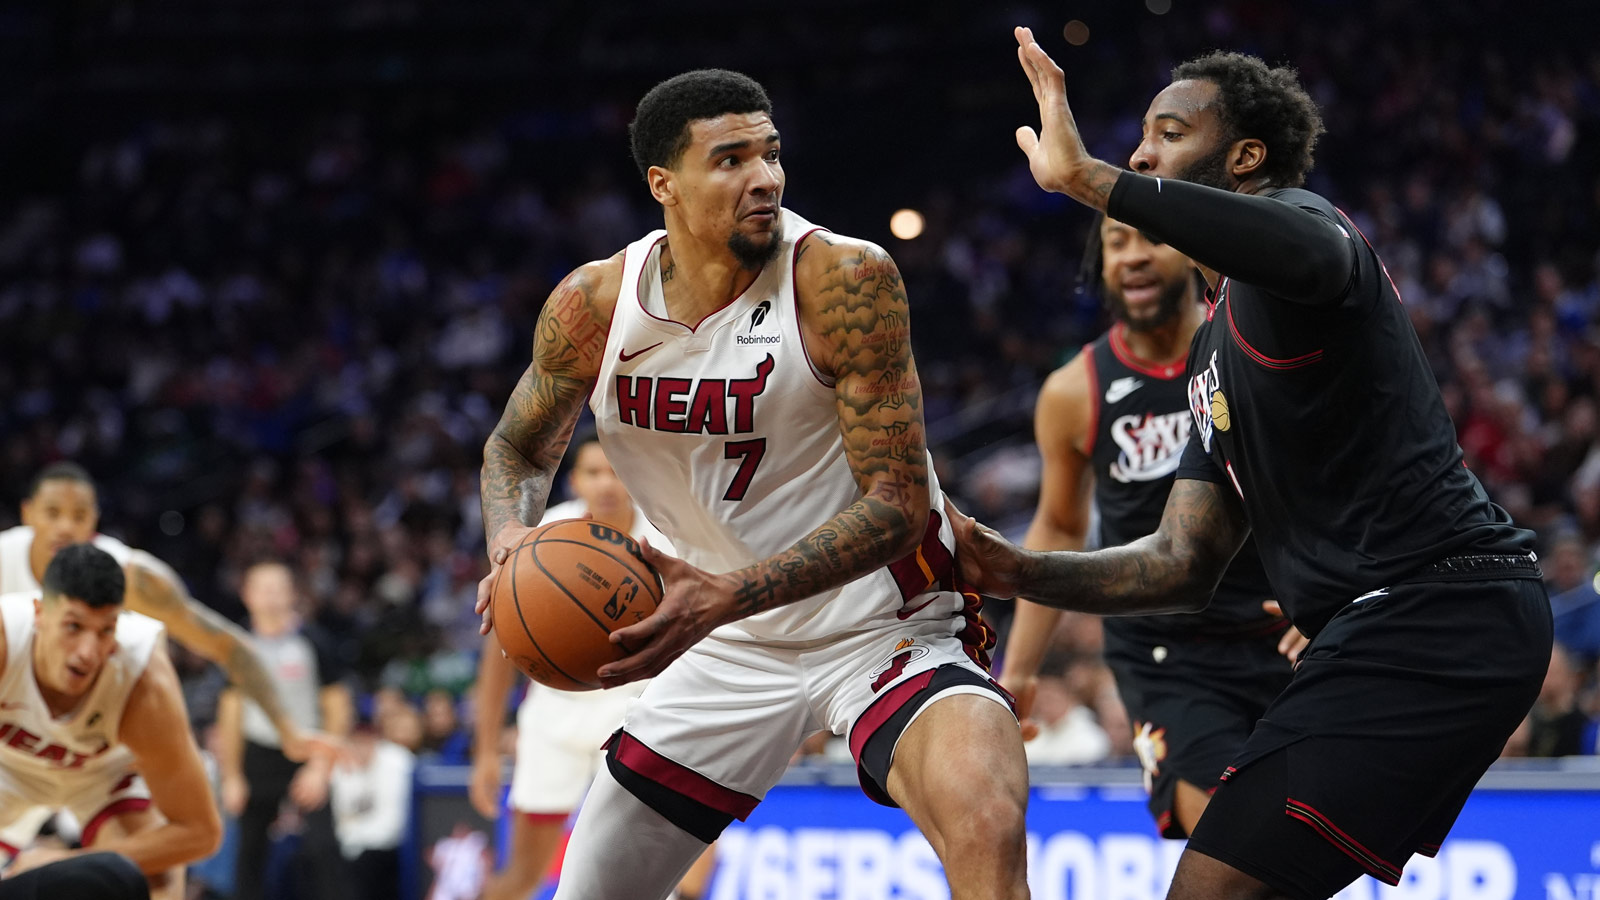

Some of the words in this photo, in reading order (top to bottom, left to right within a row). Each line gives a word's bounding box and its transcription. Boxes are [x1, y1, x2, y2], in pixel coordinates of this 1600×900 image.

[736, 334, 781, 345] Robinhood
[616, 352, 775, 435] HEAT
[722, 437, 767, 501] 7
